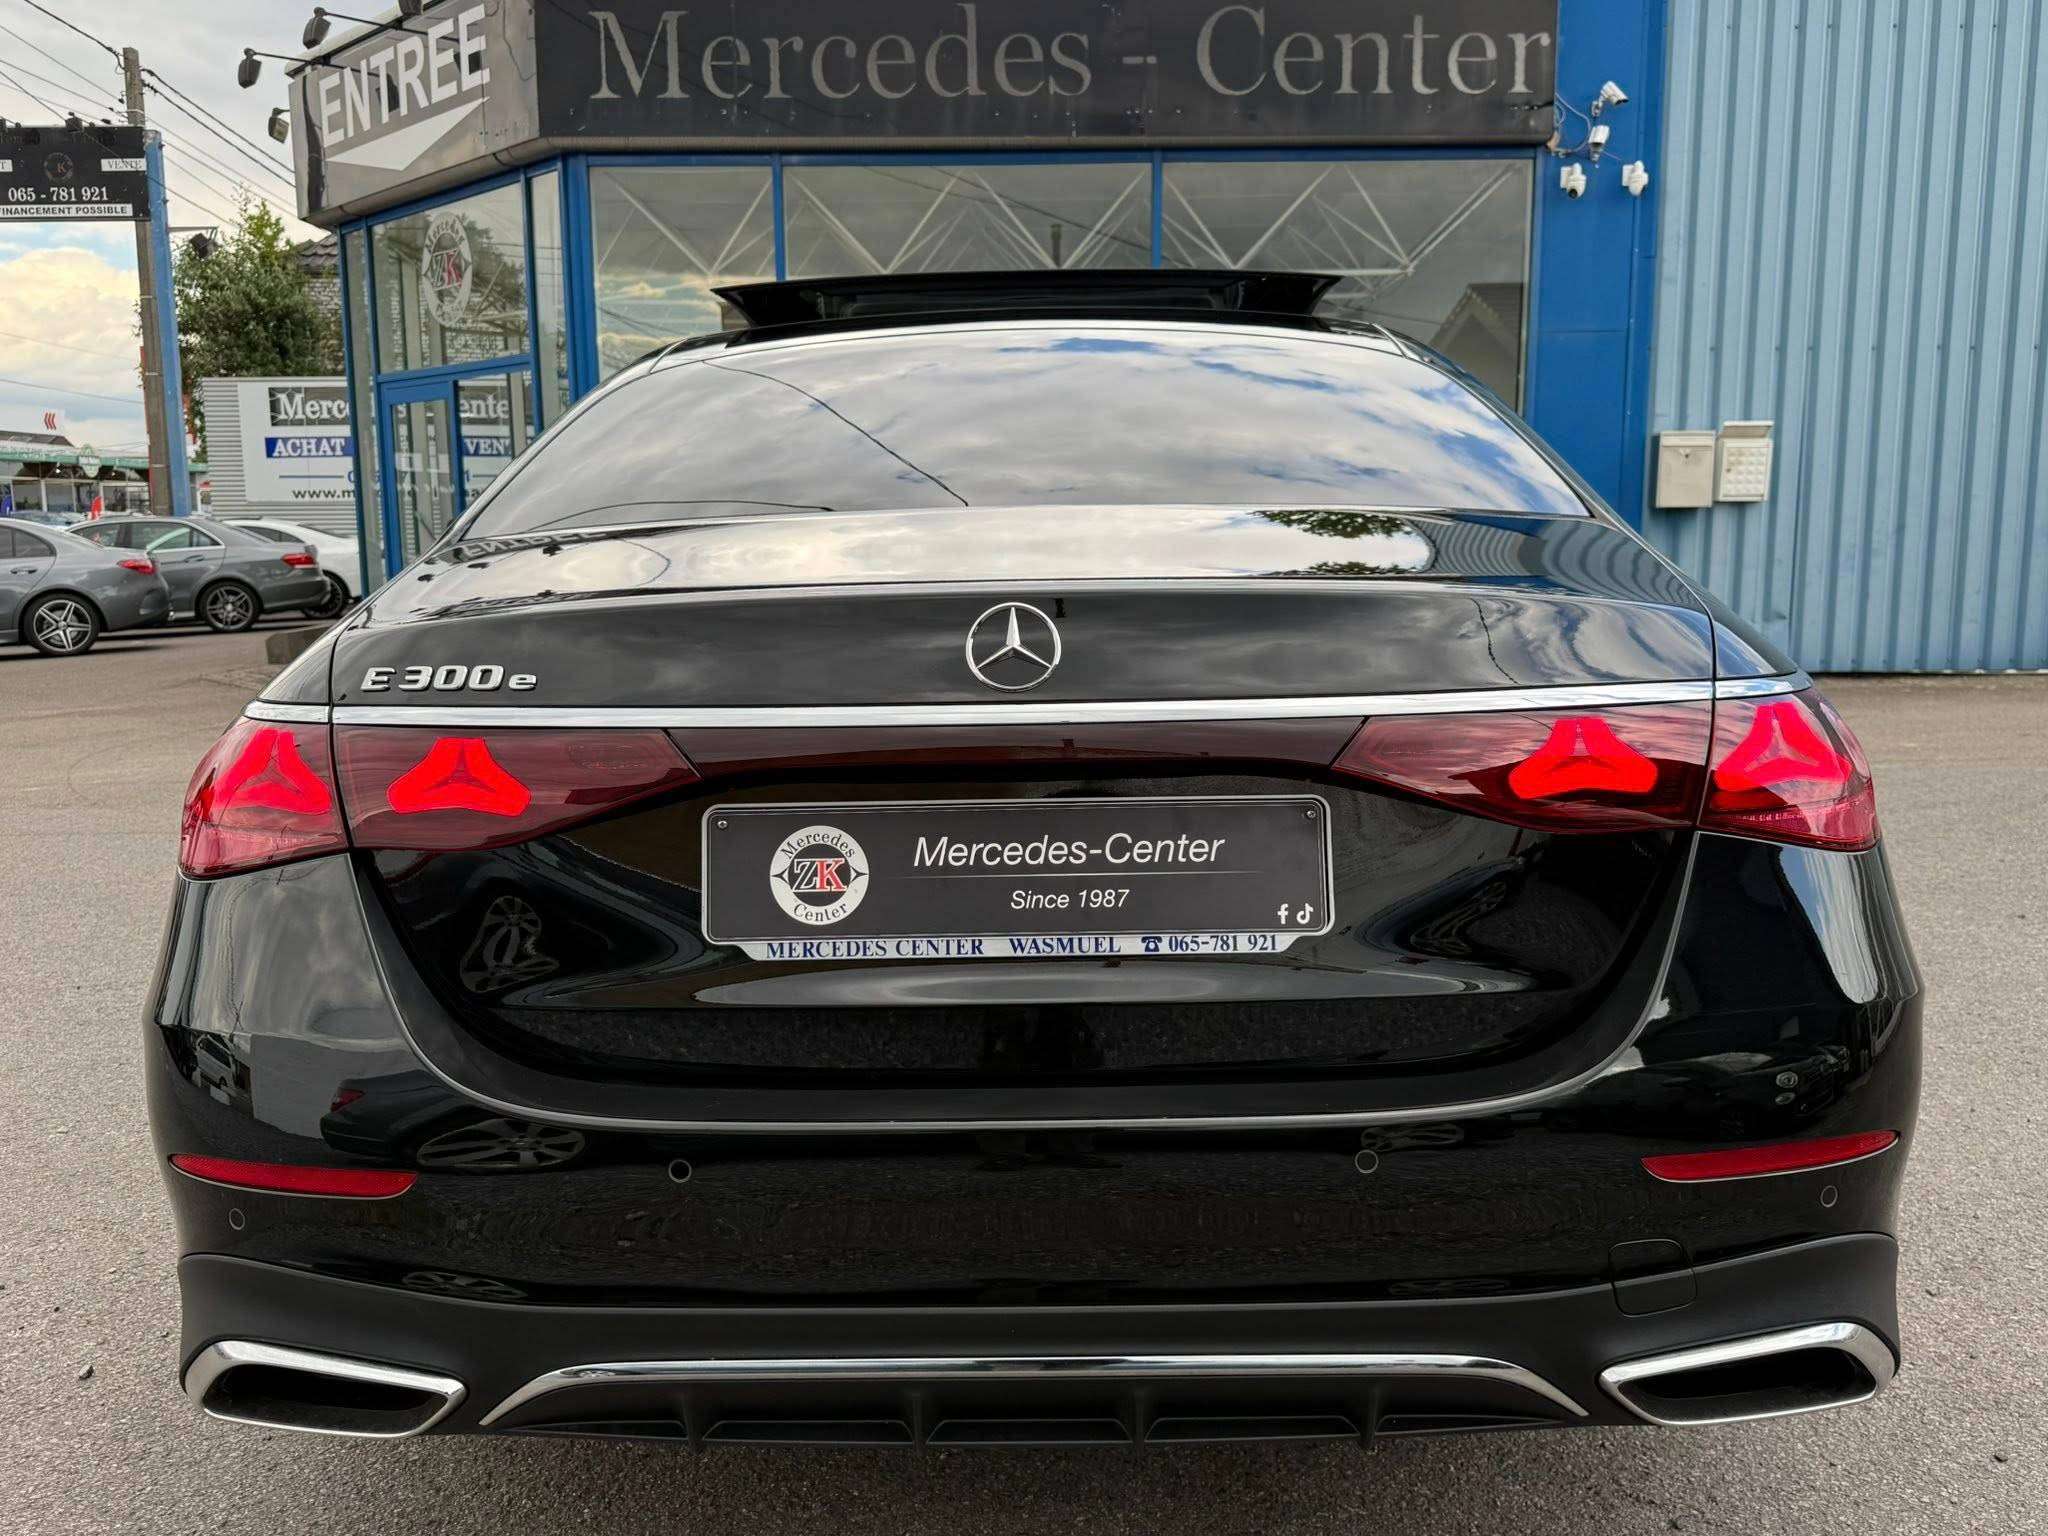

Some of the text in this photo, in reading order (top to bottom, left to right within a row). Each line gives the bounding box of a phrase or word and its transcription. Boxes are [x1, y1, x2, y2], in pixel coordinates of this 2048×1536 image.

[588, 3, 1092, 99] Mercedes
[1196, 5, 1551, 95] Center
[319, 3, 490, 148] ENTREE
[8, 187, 36, 201] 065
[50, 187, 77, 201] 781
[81, 186, 109, 201] 921
[76, 205, 128, 216] POSSIBLE
[278, 393, 351, 420] Merc
[272, 438, 345, 457] ACHAT
[780, 833, 856, 860] Mercedes
[913, 832, 1226, 867] Mercedes-Center
[792, 858, 848, 892] ZK
[1010, 889, 1131, 909] Since 1987
[793, 903, 848, 922] Center
[766, 933, 1279, 959] MERCEDES CENTER WASMUEL 065-781 921
